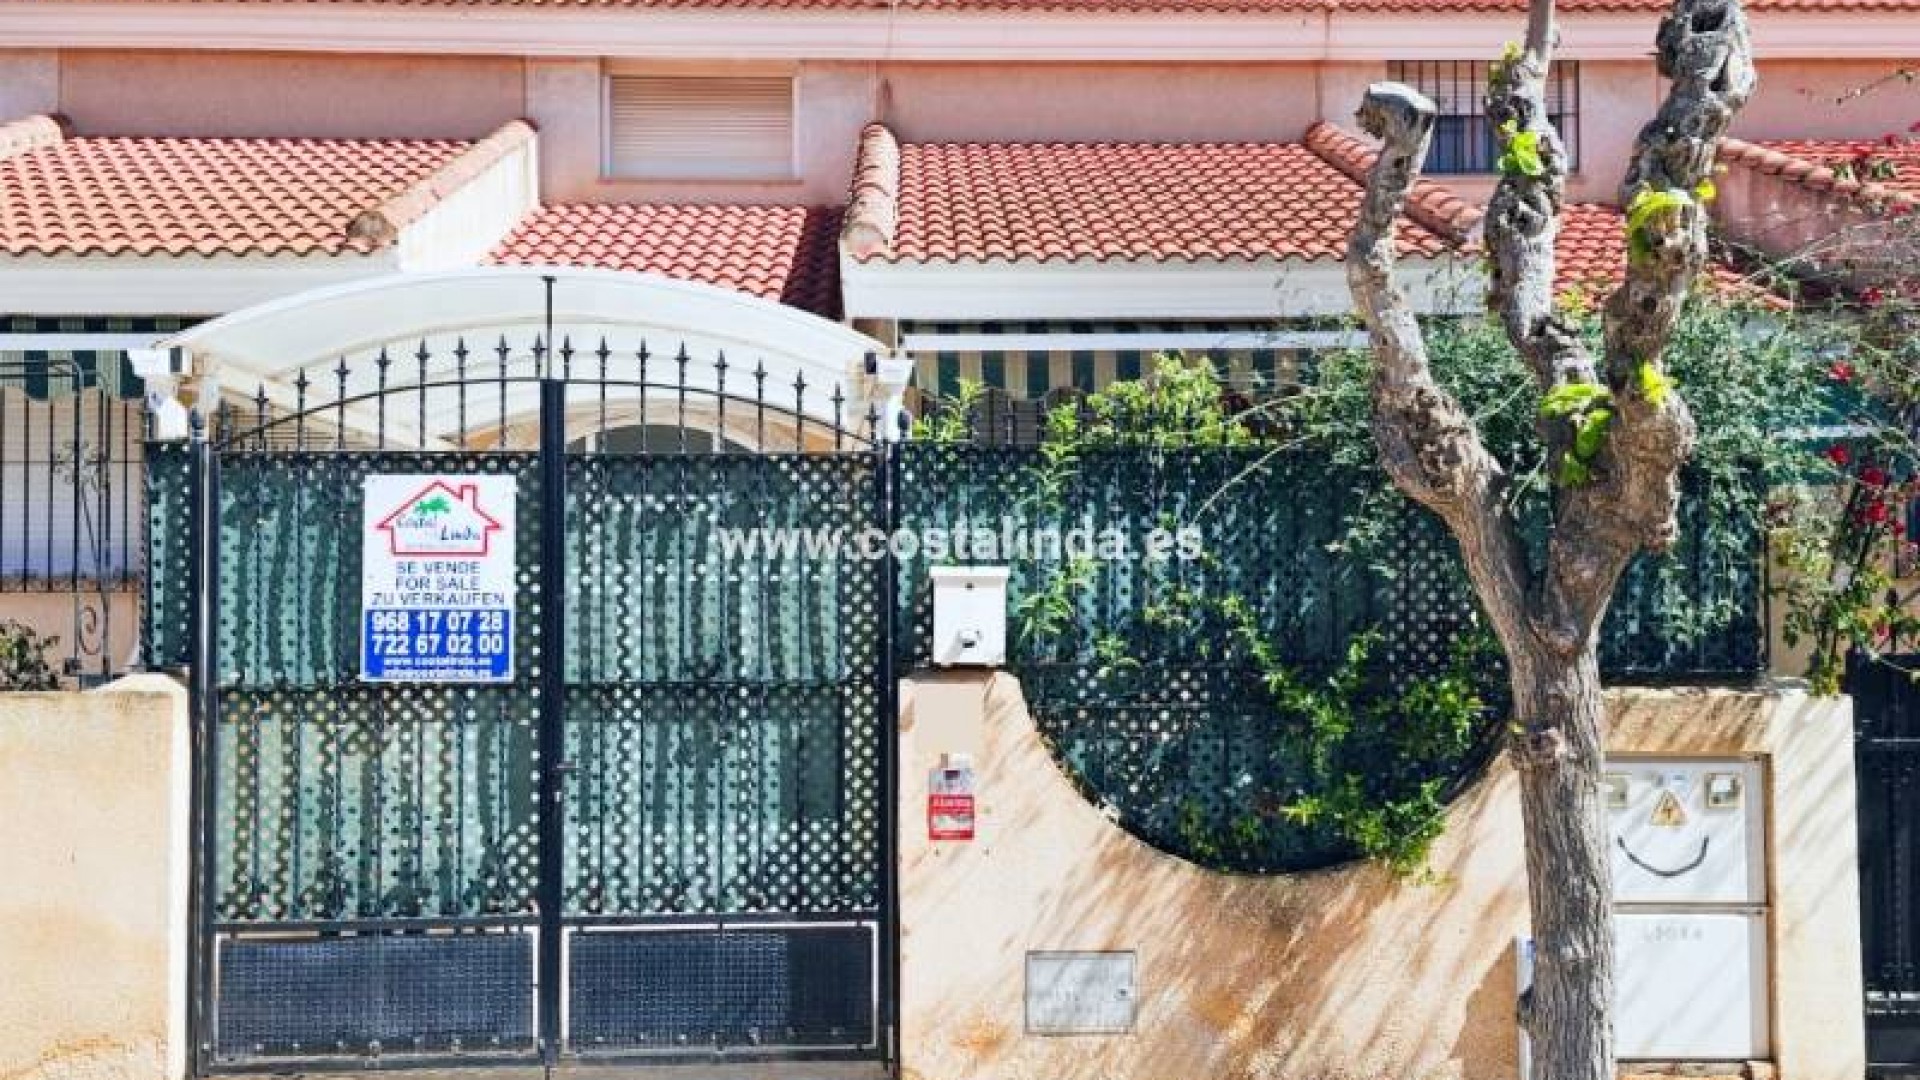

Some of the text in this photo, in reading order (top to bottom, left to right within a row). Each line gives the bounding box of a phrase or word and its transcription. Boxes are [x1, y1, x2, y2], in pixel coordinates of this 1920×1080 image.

[396, 561, 481, 575] SE VENDE
[396, 576, 481, 590] FOR SALE
[372, 593, 505, 605] ZU VERKAUFEN
[372, 611, 504, 632] 968 17 07 28
[372, 633, 504, 656] 722 67 02 00
